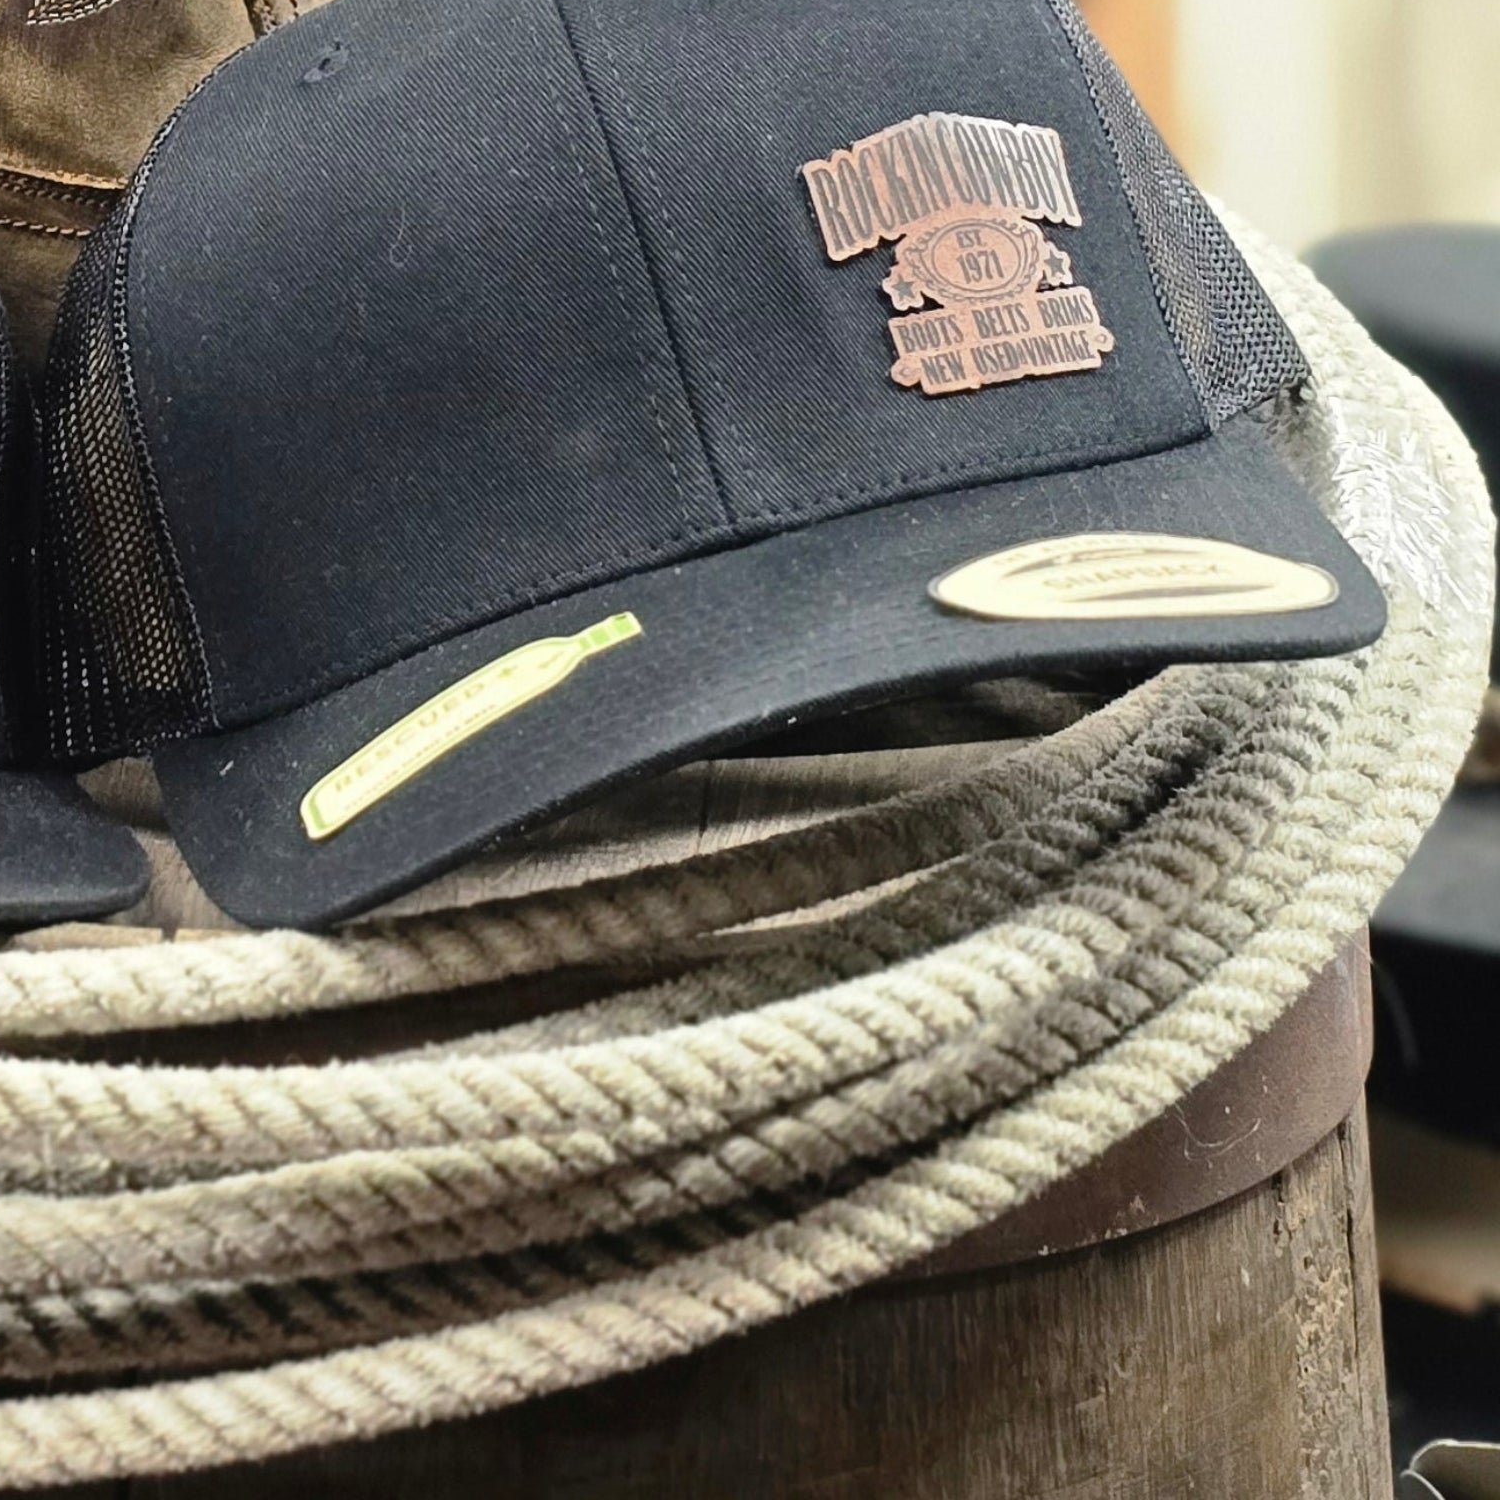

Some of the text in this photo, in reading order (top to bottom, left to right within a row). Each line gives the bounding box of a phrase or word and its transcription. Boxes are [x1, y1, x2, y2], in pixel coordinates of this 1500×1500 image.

[956, 249, 1005, 284] 1971
[894, 294, 1095, 353] BOOTS BELTS BRIMS
